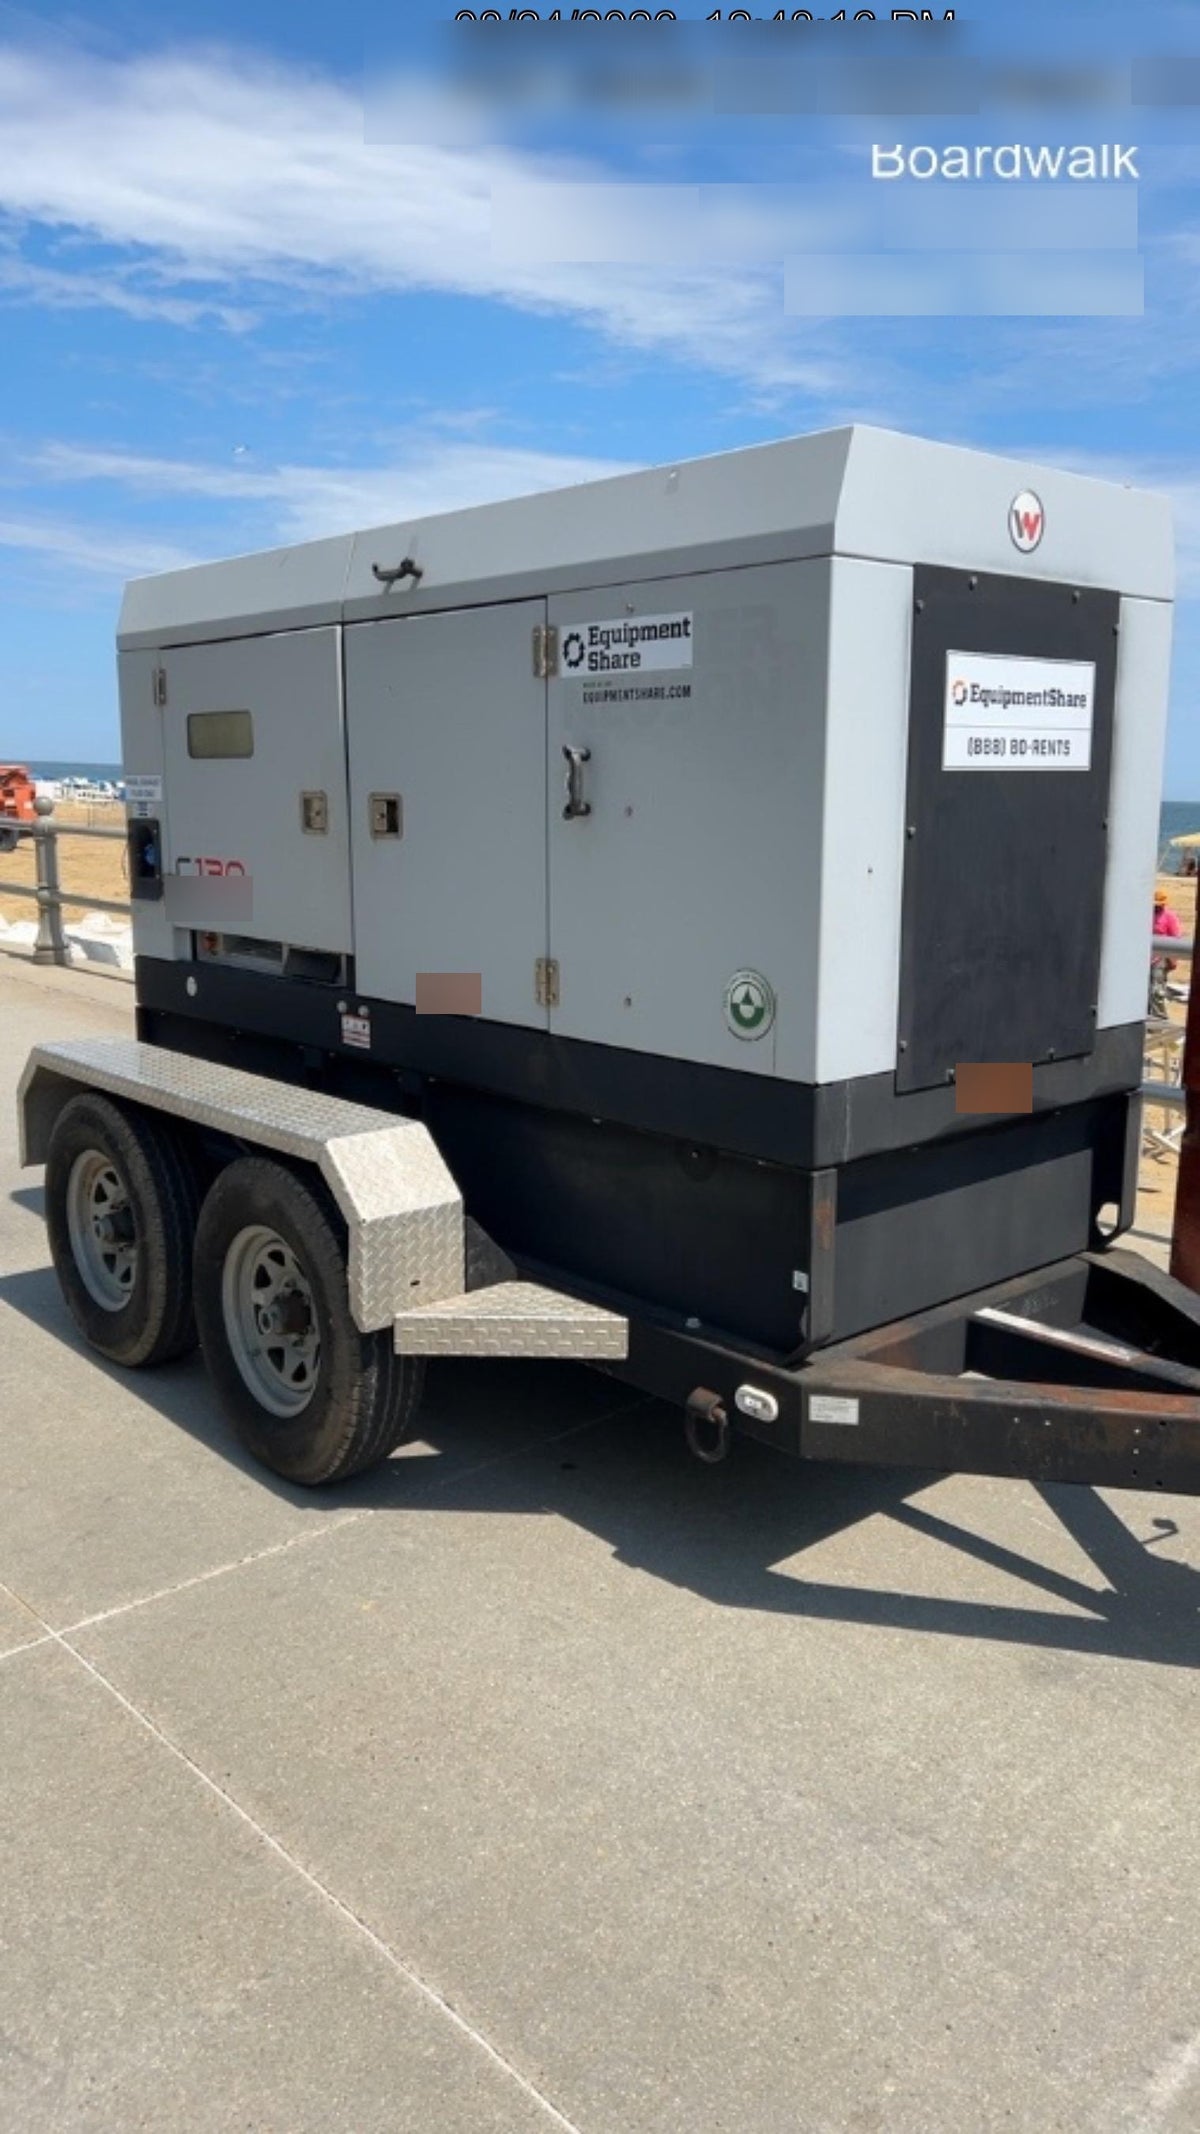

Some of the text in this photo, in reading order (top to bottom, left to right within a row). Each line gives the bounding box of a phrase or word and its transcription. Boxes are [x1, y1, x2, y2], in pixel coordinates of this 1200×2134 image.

[587, 616, 691, 649] Equipment
[587, 651, 642, 672] Share
[582, 685, 692, 705] EQUIPMENTSHARE.COM
[970, 683, 1087, 709] EquipmentShare
